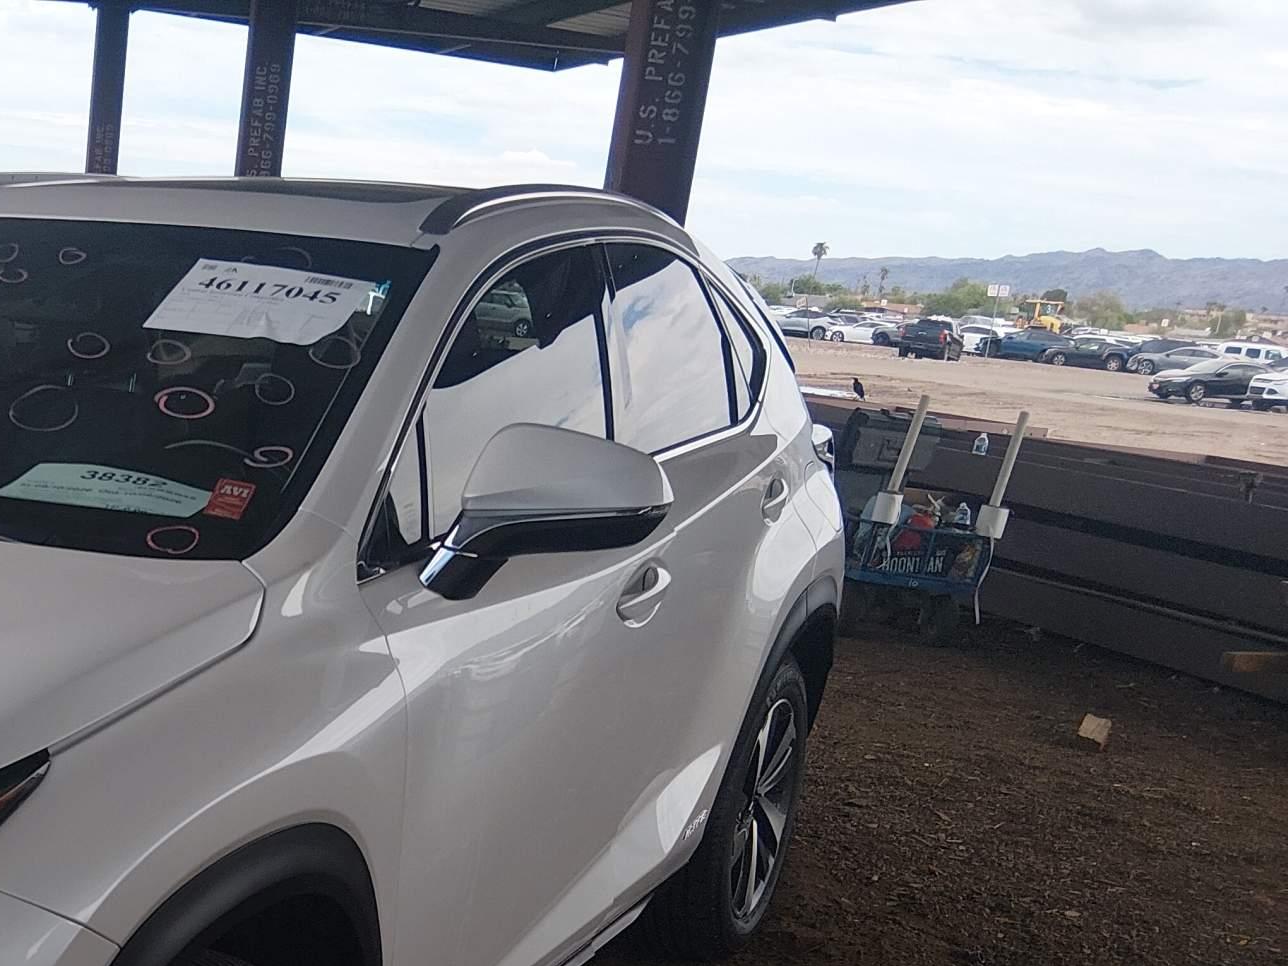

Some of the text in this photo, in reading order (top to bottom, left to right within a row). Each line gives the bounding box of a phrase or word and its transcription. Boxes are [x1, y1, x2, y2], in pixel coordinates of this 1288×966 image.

[254, 61, 269, 90] INC.
[657, 0, 697, 145] 1-866-799
[247, 98, 265, 158] PREFAB
[633, 97, 660, 145] U.S.
[198, 276, 342, 305] 46117045
[80, 470, 168, 487] 38382
